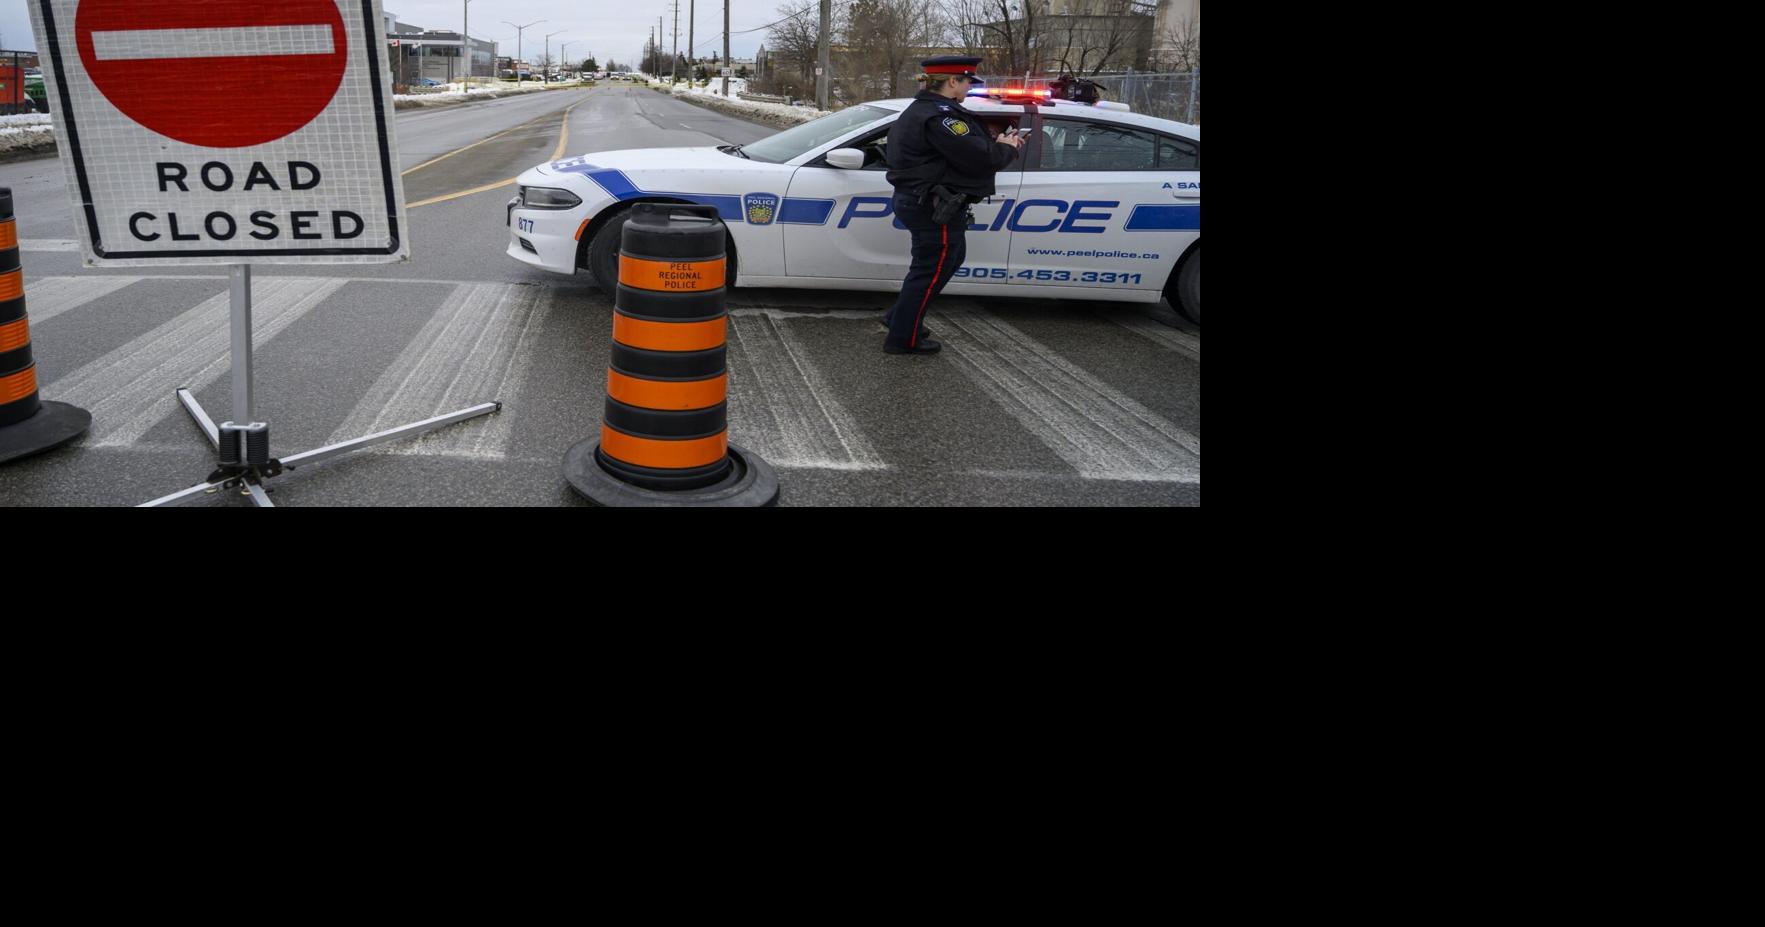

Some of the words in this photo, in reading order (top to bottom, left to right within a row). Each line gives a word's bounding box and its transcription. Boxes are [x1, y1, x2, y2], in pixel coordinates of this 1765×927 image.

[156, 161, 322, 192] ROAD
[837, 197, 1120, 233] PICE
[129, 211, 365, 241] CLOSED
[518, 217, 534, 234] 877
[1027, 248, 1160, 260] www.peelpolice.ca
[670, 263, 693, 271] PEEL
[659, 272, 702, 280] REGIONAL
[664, 280, 697, 289] POLICE
[954, 267, 1141, 285] 905.453.3311
